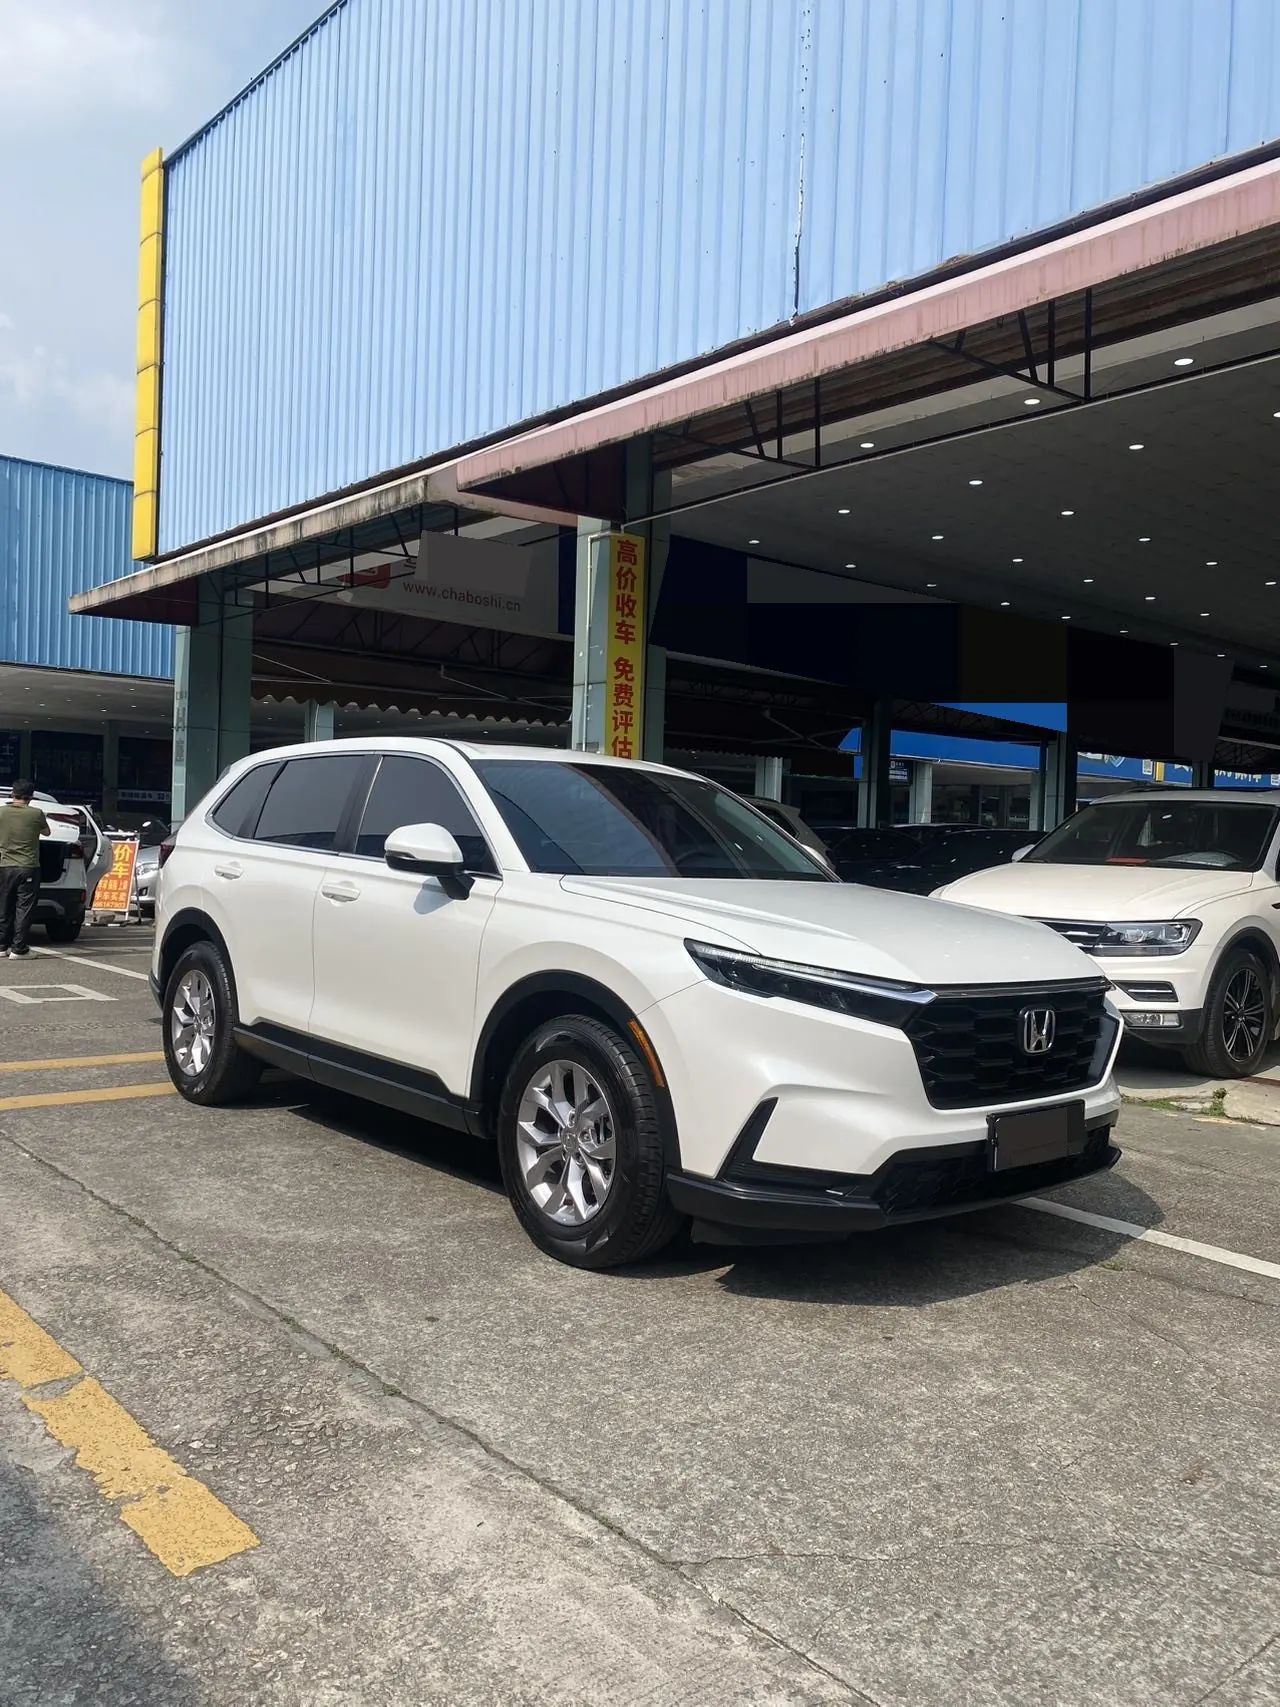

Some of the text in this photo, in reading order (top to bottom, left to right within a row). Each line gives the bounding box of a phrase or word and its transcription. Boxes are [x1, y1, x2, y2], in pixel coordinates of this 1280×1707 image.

[402, 581, 521, 612] www.chaboshi.cn
[612, 540, 637, 760] 高价收车 免费评估
